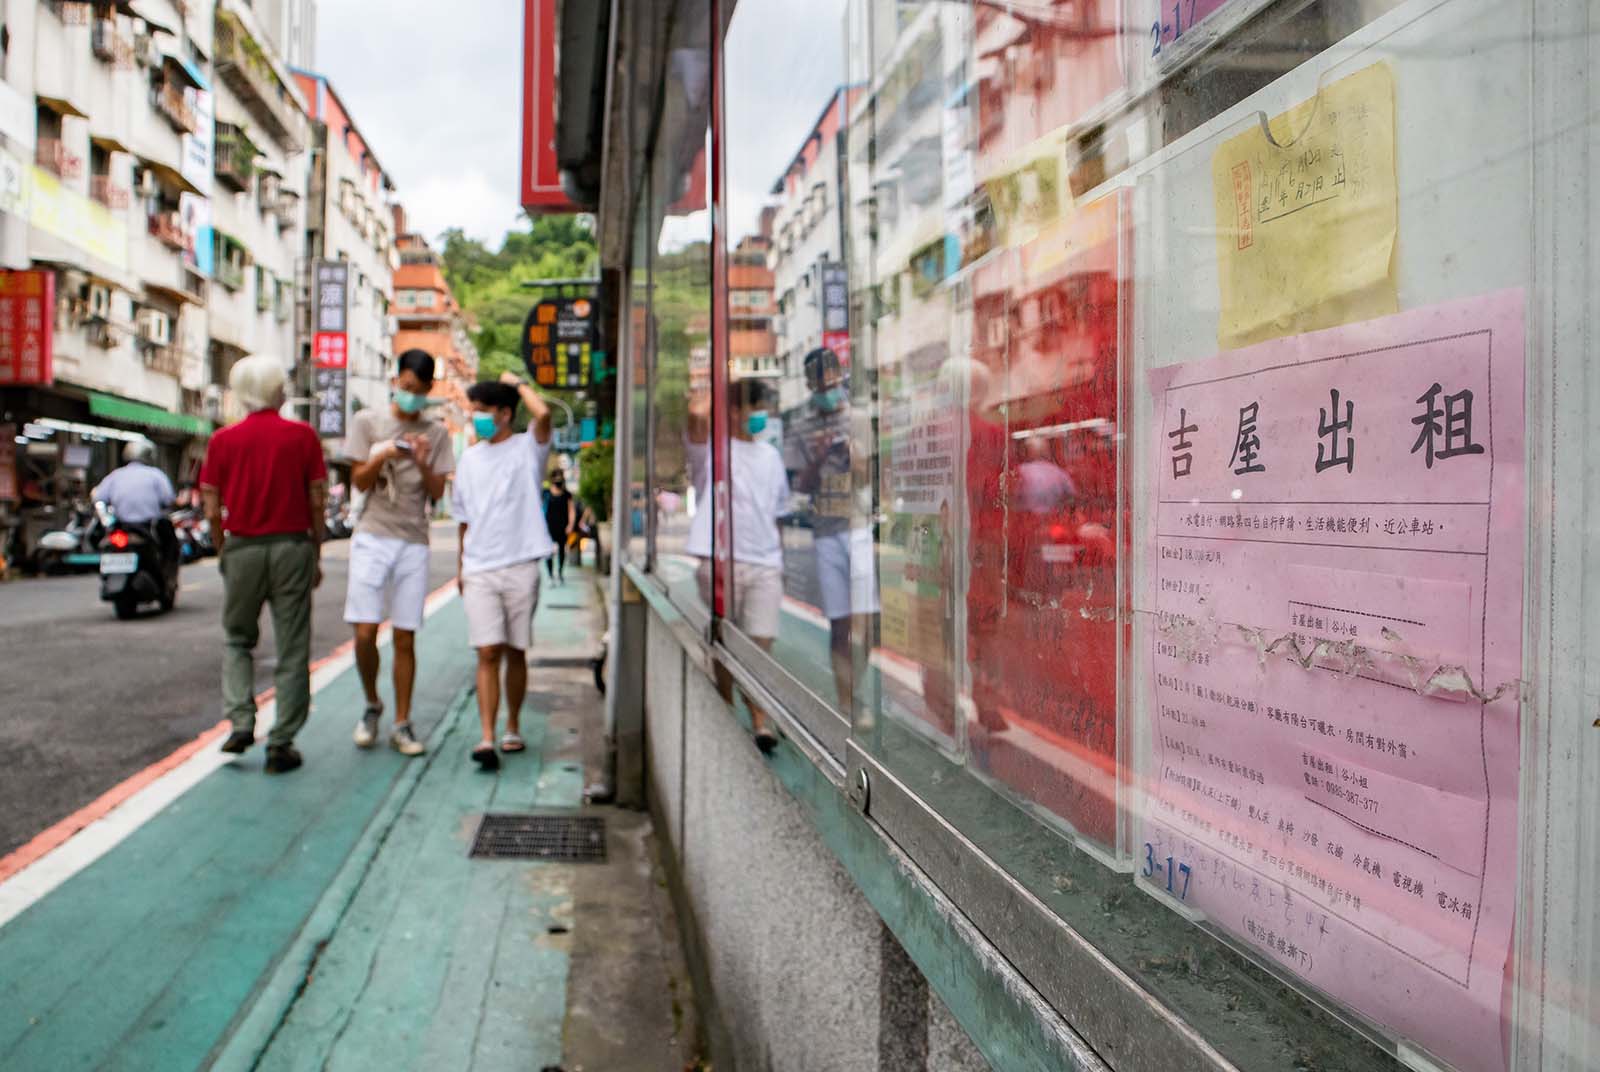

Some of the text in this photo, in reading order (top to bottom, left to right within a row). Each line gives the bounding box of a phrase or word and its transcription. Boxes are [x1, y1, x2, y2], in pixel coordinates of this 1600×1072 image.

[1168, 382, 1484, 480] 吉屋出租
[1143, 842, 1192, 900] 3-17
[1352, 853, 1383, 879] 冷氣機
[1392, 871, 1425, 898] 電視機
[1436, 891, 1473, 920] 電冰箱
